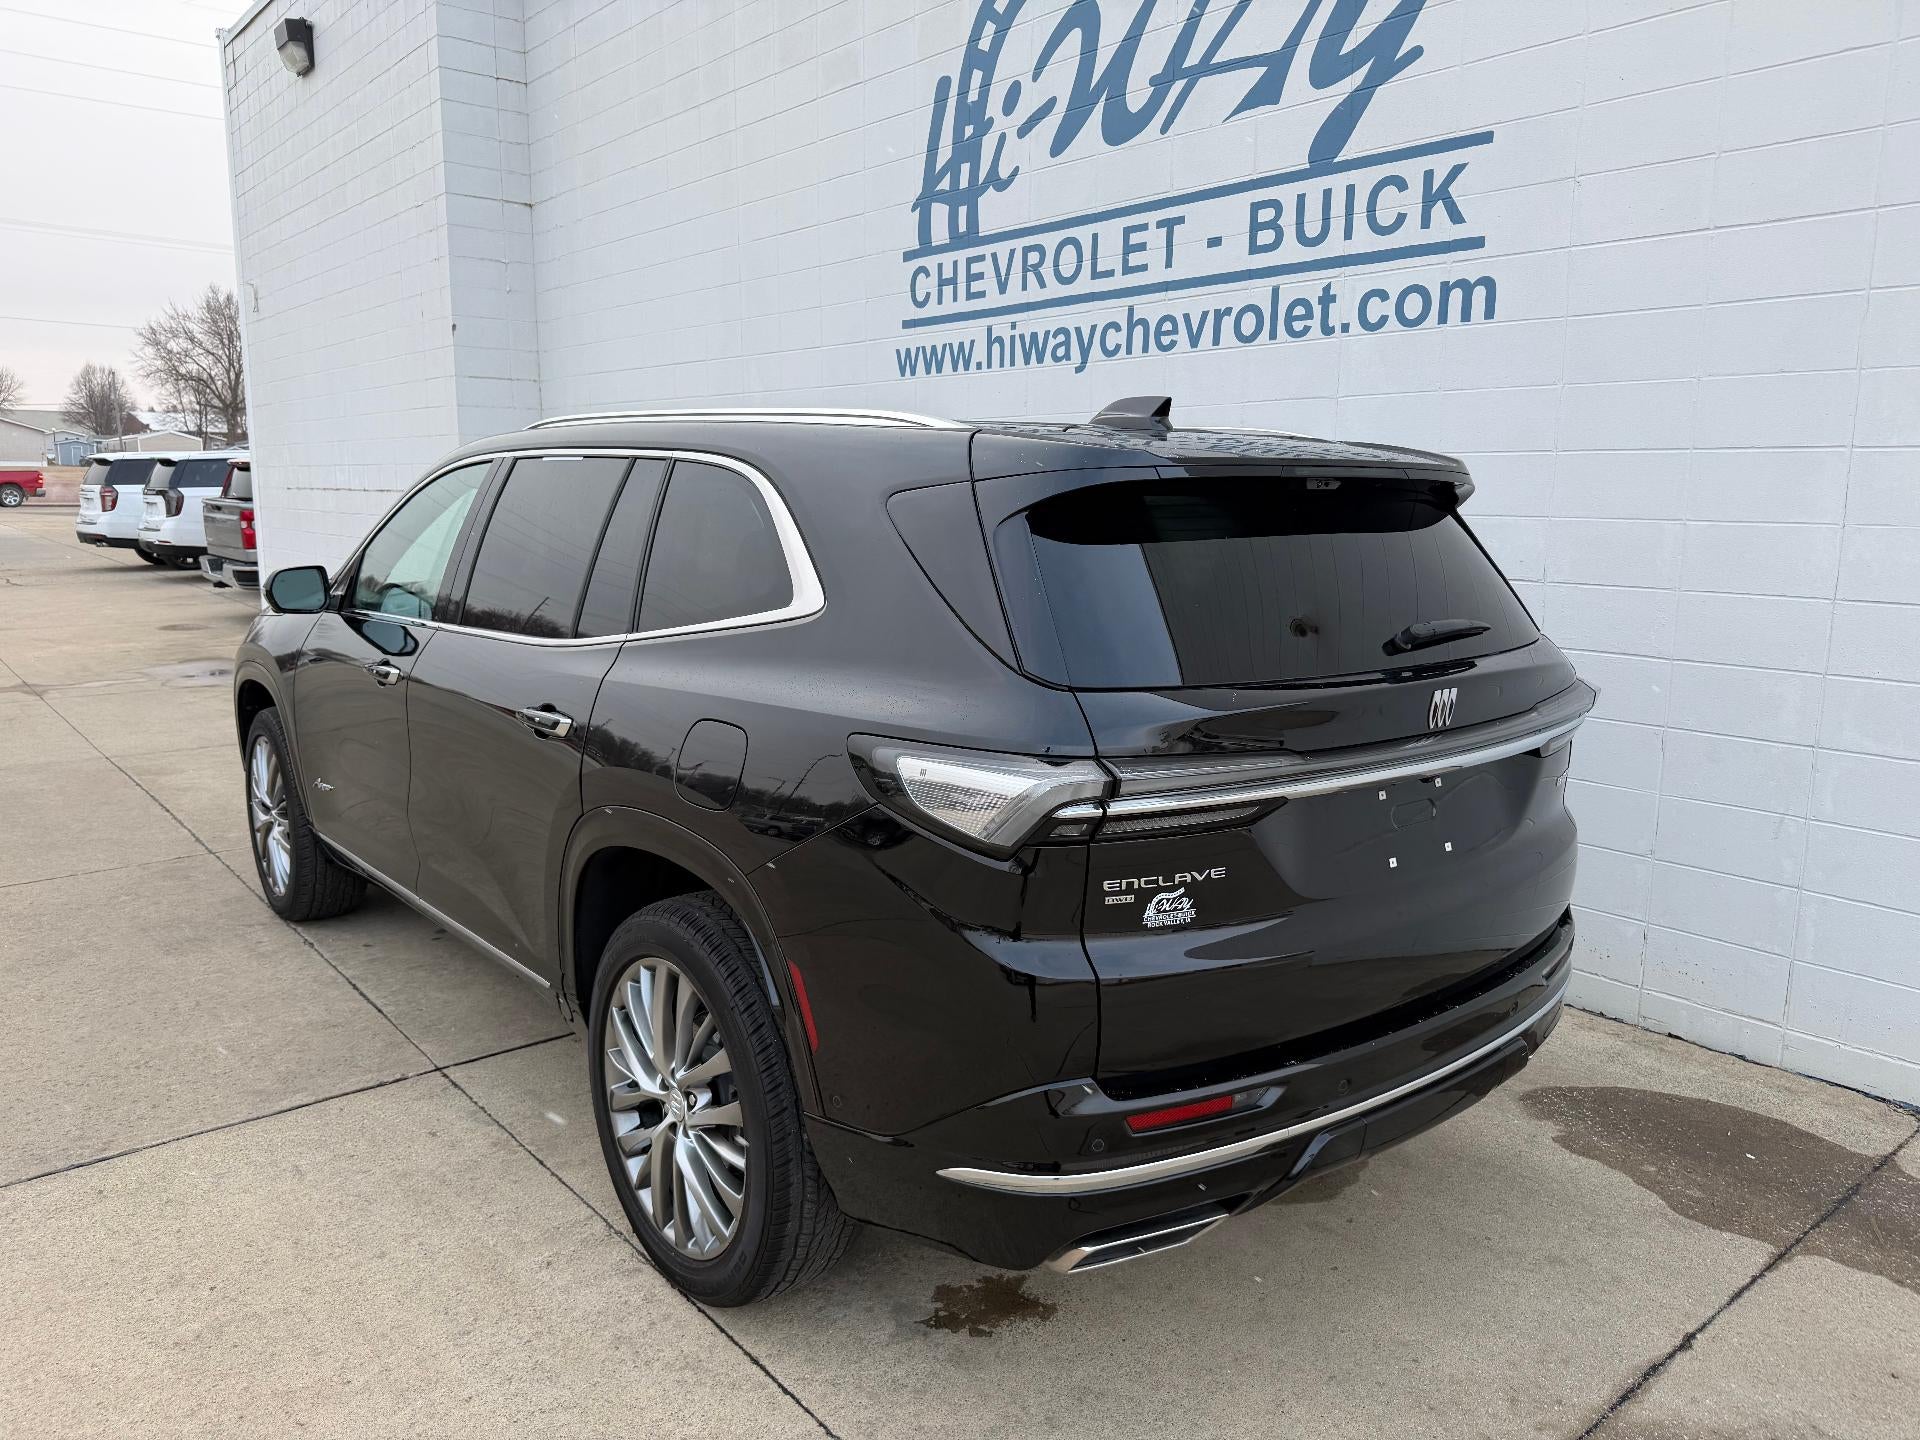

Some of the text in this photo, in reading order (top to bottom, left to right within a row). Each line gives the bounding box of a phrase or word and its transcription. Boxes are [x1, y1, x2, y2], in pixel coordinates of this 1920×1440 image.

[909, 215, 1185, 309] CHEVROLET
[1248, 162, 1470, 257] BUICK
[895, 275, 1498, 377] www.hiwaychevrolet.com
[1103, 867, 1226, 891] ENCLAVE
